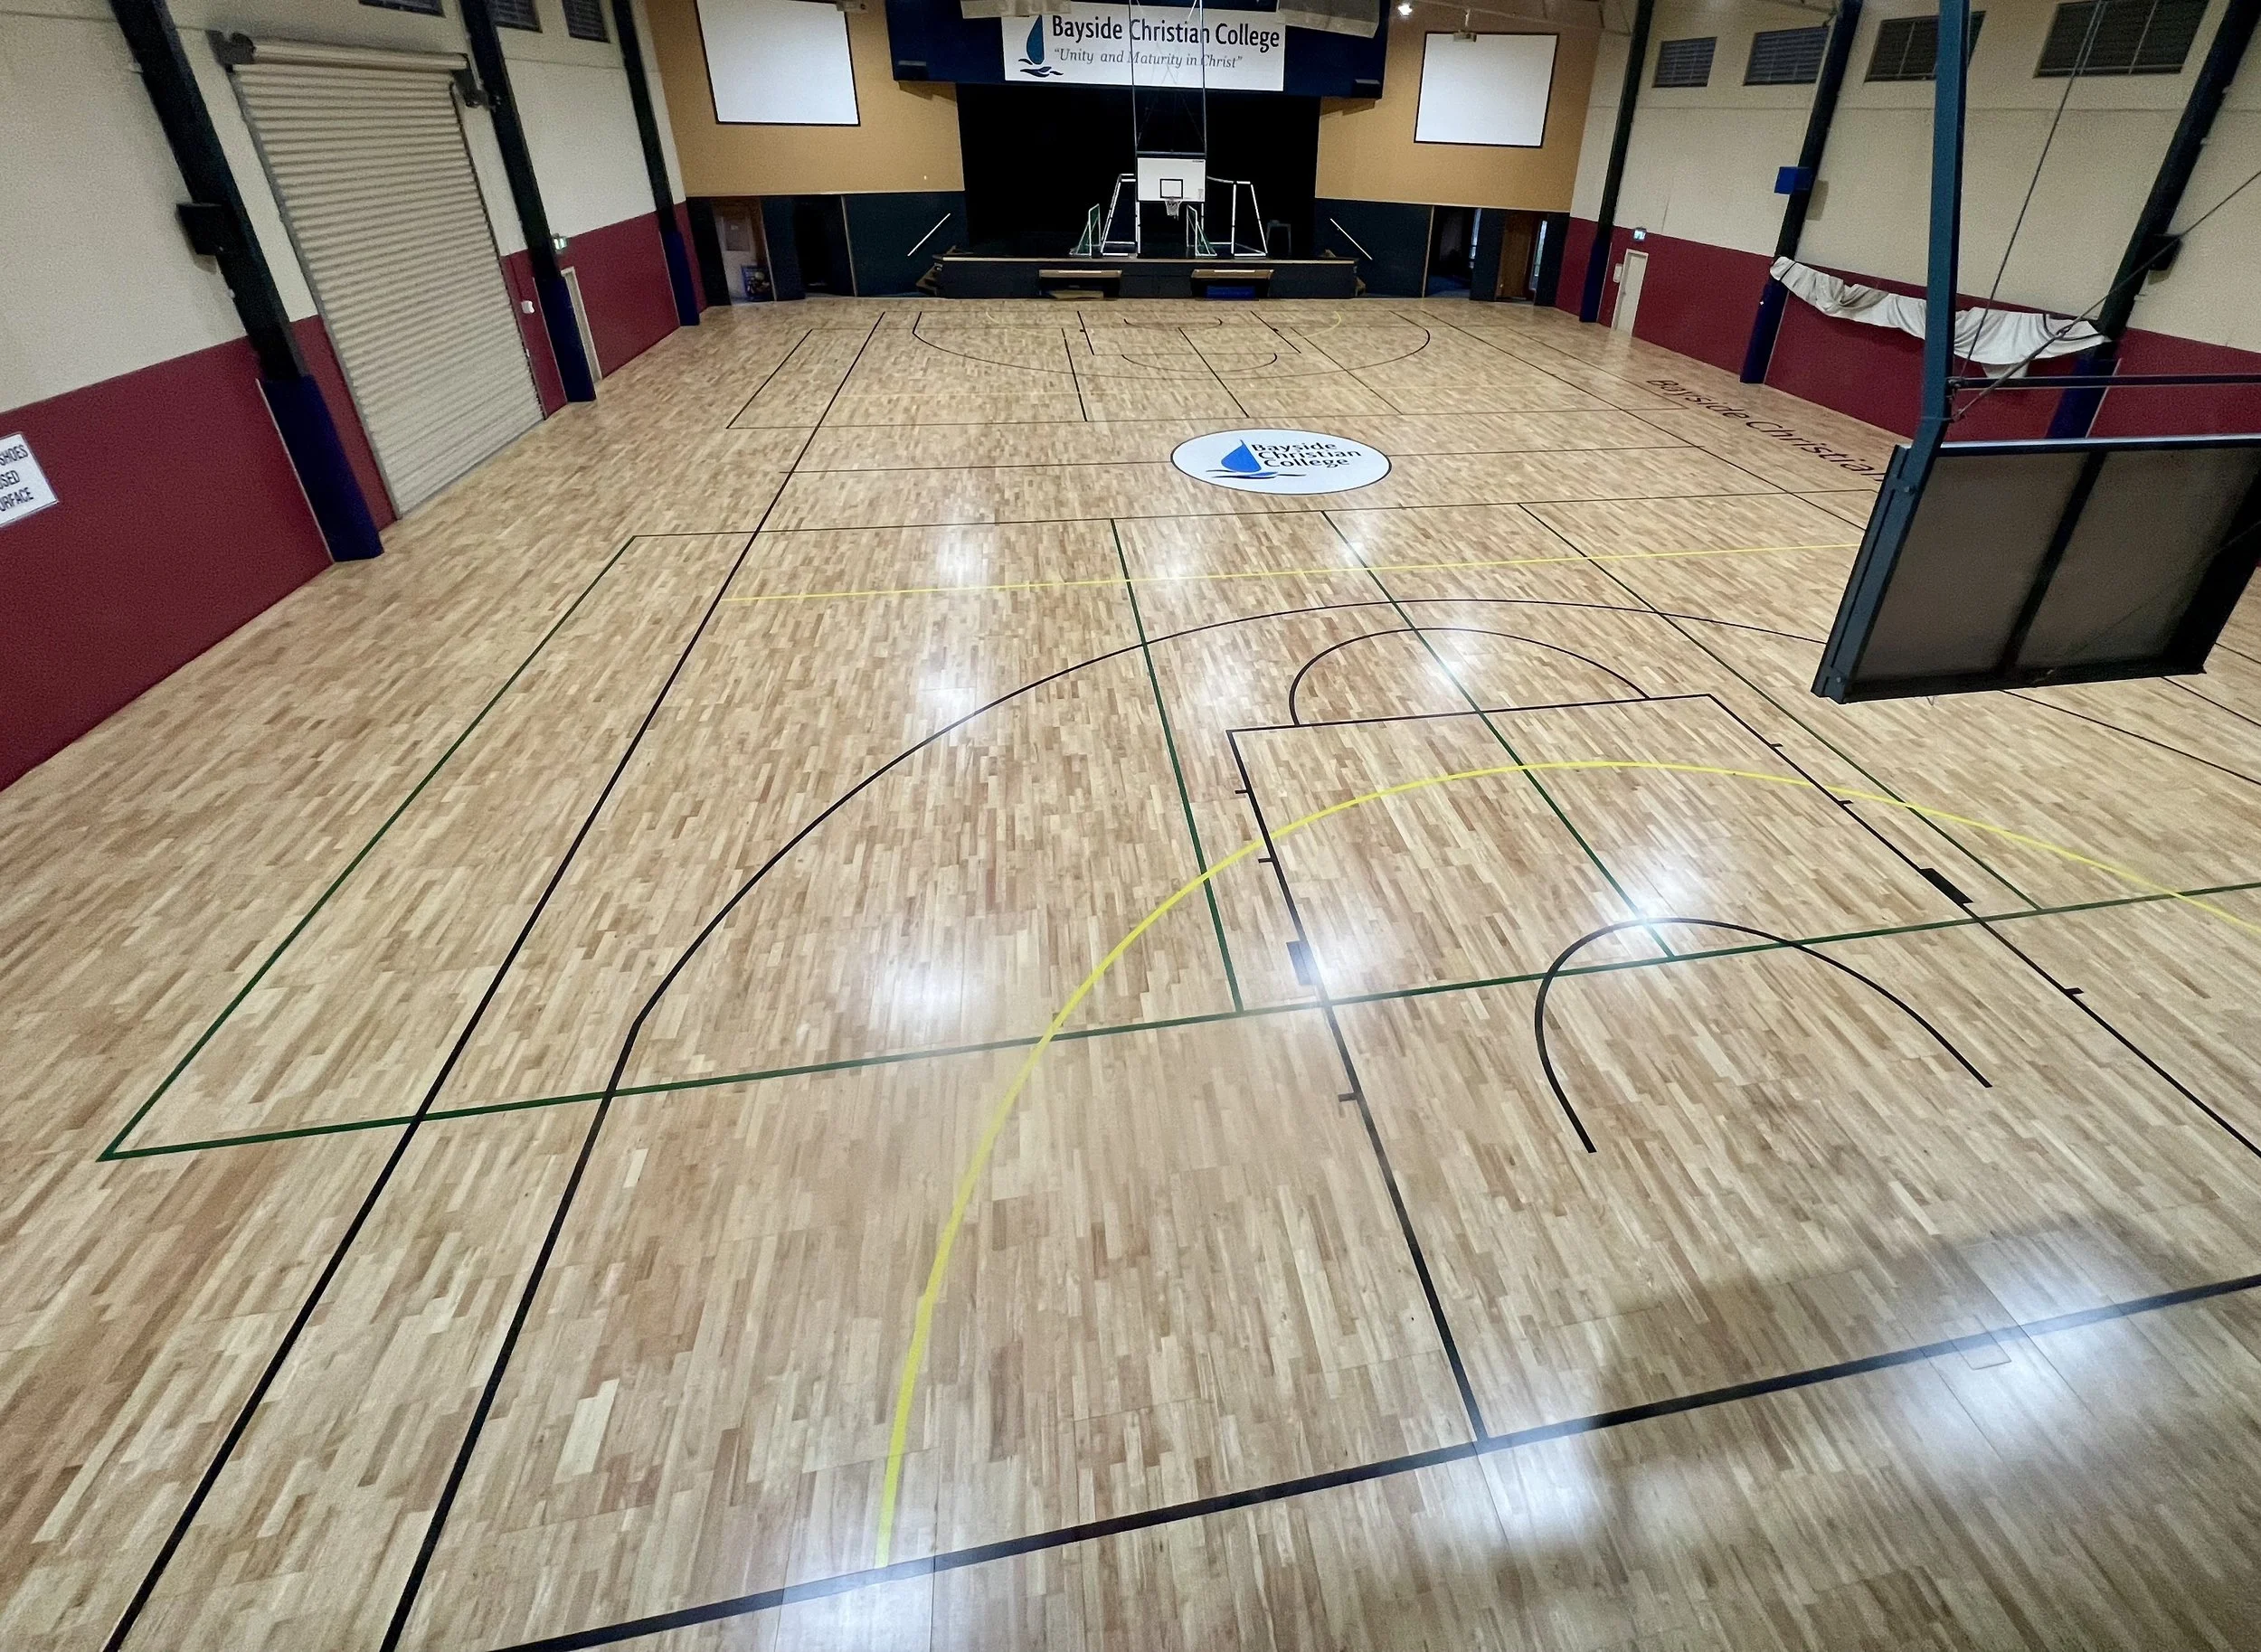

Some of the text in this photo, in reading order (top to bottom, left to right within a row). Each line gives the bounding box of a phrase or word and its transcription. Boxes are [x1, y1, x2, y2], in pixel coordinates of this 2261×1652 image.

[1052, 14, 1281, 52] Bayside Christian College
[1100, 50, 1124, 63] and
[1127, 51, 1183, 68] Maturity
[1186, 53, 1197, 66] in
[1646, 380, 1750, 420] Bayside
[1251, 441, 1338, 453] Bayside
[1258, 448, 1362, 459] Christian
[1263, 458, 1350, 468] College
